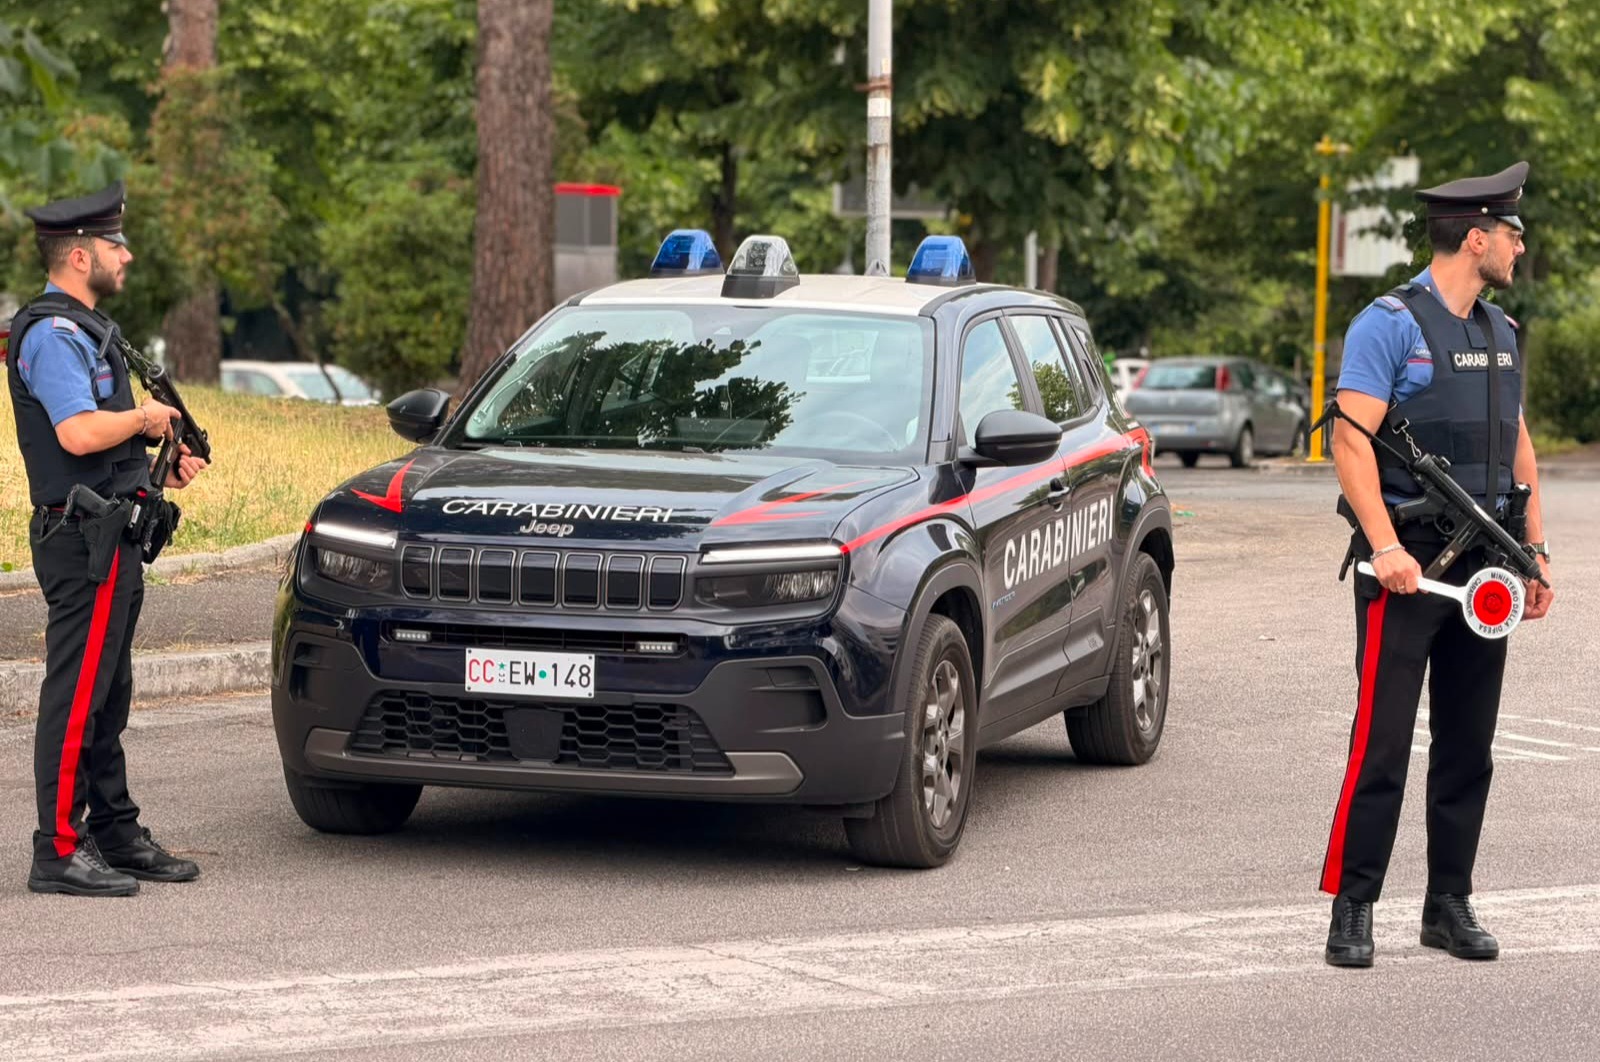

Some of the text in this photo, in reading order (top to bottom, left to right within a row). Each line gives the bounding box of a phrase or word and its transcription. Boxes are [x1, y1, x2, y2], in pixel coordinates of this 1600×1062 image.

[1454, 352, 1513, 367] CARABIERI
[442, 499, 675, 523] CARABINIERI
[519, 519, 574, 537] Jeep
[1003, 494, 1114, 590] CARABINIERI
[1478, 572, 1519, 634] MINISTERO DELLA DIFESA
[469, 658, 591, 688] CC EW 148
